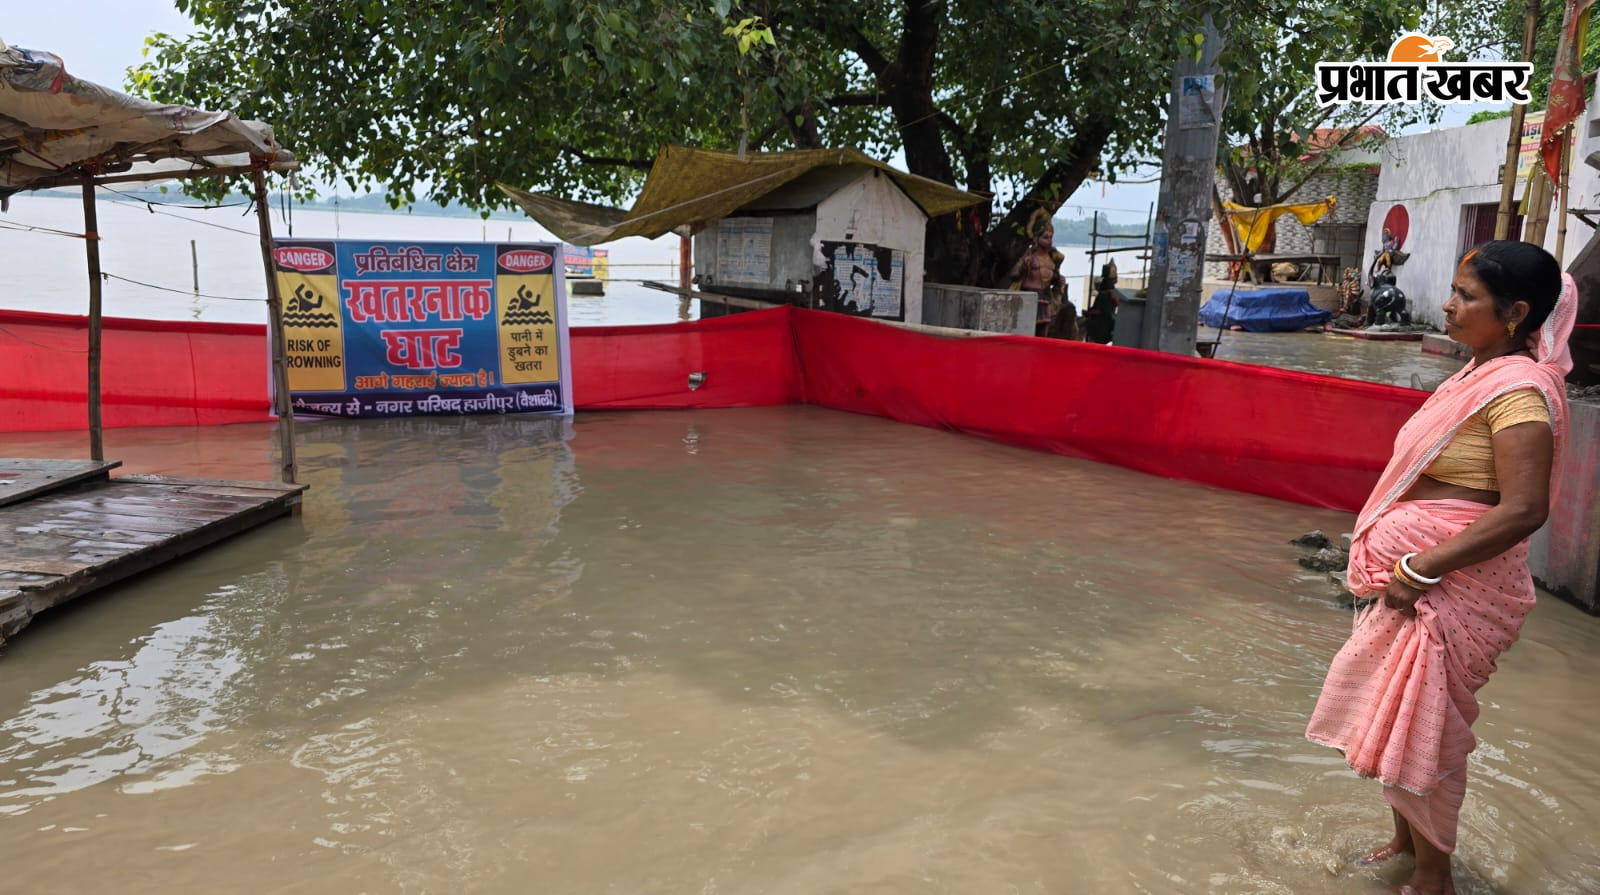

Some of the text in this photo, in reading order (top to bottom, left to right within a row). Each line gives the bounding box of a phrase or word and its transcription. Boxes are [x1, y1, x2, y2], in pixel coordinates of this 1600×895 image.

[354, 246, 479, 276] प्रतिबंधित क्षेत्र
[505, 254, 545, 267] DANGER
[342, 279, 493, 322] खतरनाक
[511, 328, 544, 342] पानी में
[288, 339, 331, 352] RISK OF
[381, 328, 463, 369] घाट
[534, 345, 548, 355] का
[287, 355, 341, 368] ROWNING
[514, 361, 542, 371] खतरा
[355, 370, 388, 389] आगे
[391, 370, 436, 389] गहराई
[346, 397, 360, 415] से
[376, 401, 413, 413] नगर
[464, 393, 513, 413] हाजीपुर
[516, 389, 557, 410] (वैशाली)
